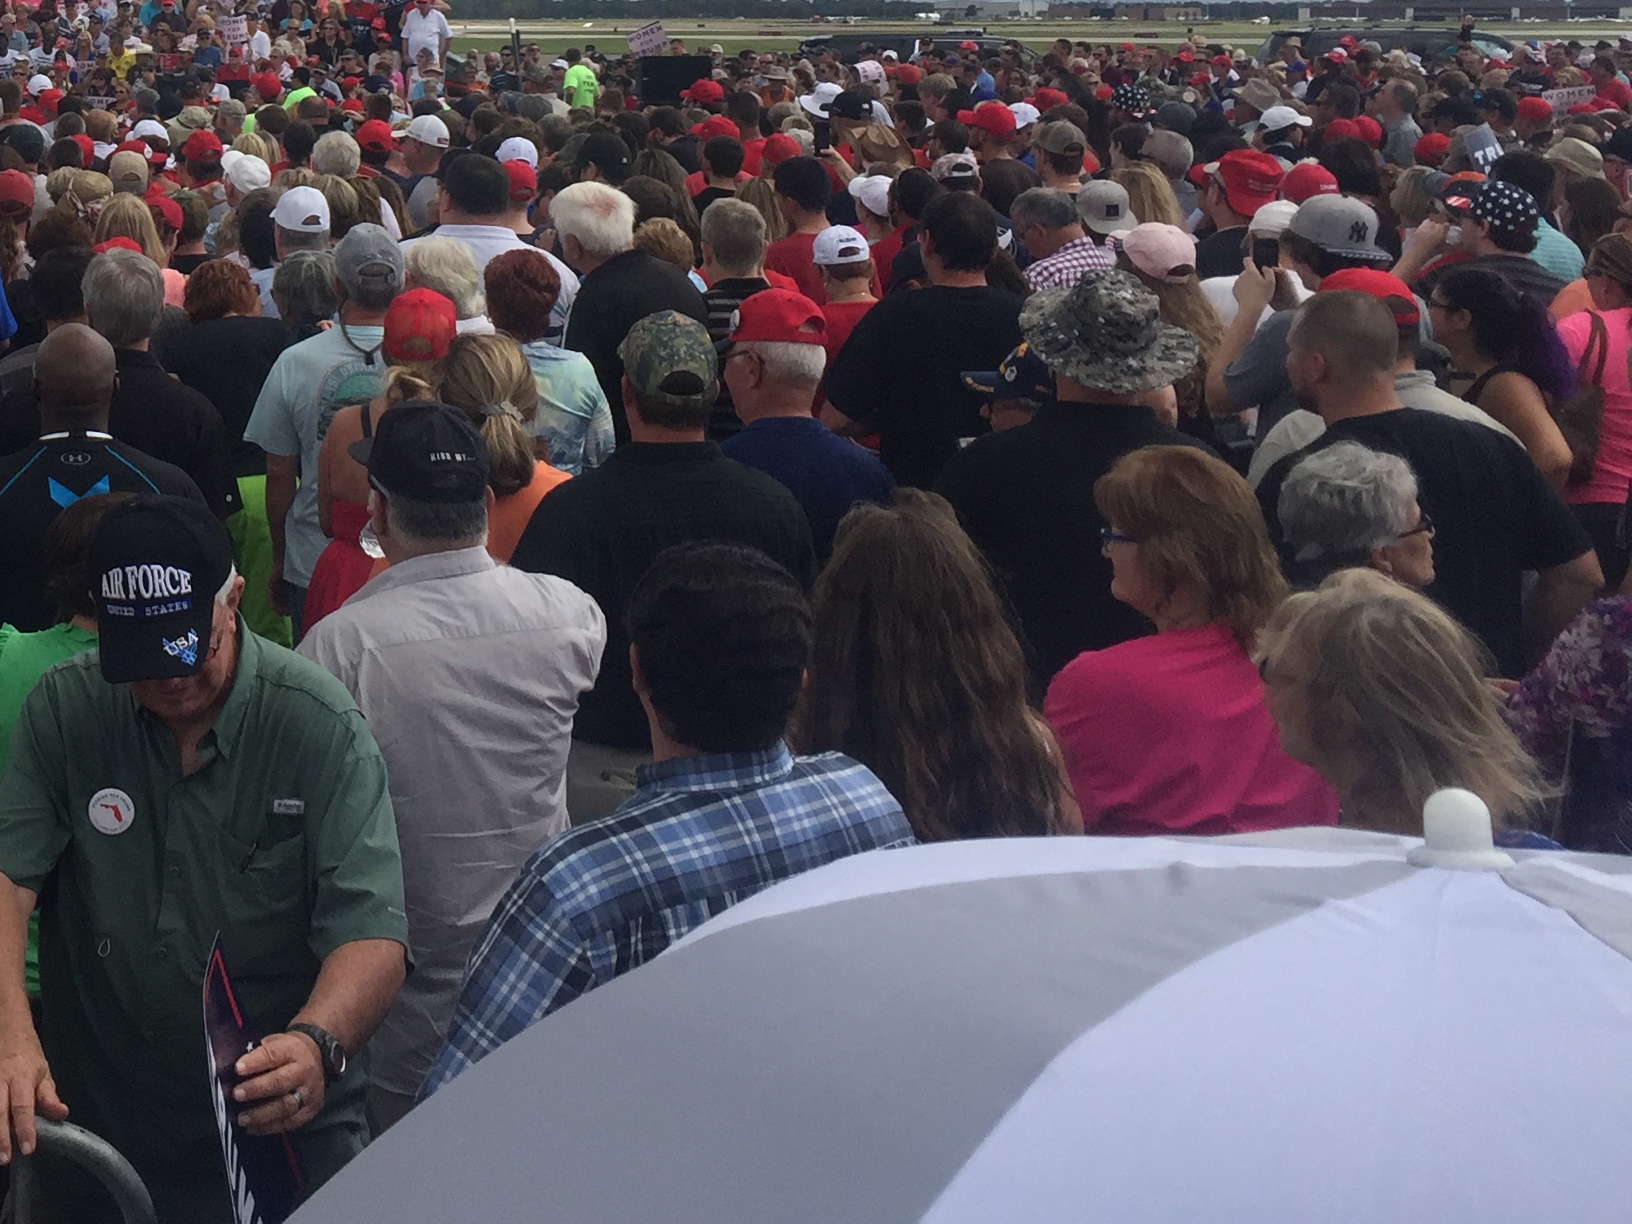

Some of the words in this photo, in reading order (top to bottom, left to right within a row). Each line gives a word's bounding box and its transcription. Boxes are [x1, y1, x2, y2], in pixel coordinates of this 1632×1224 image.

[1543, 88, 1596, 100] WOMEN
[101, 567, 127, 600] AIR
[124, 564, 193, 600] FORCE
[144, 600, 188, 617] STATES
[163, 631, 199, 656] USA
